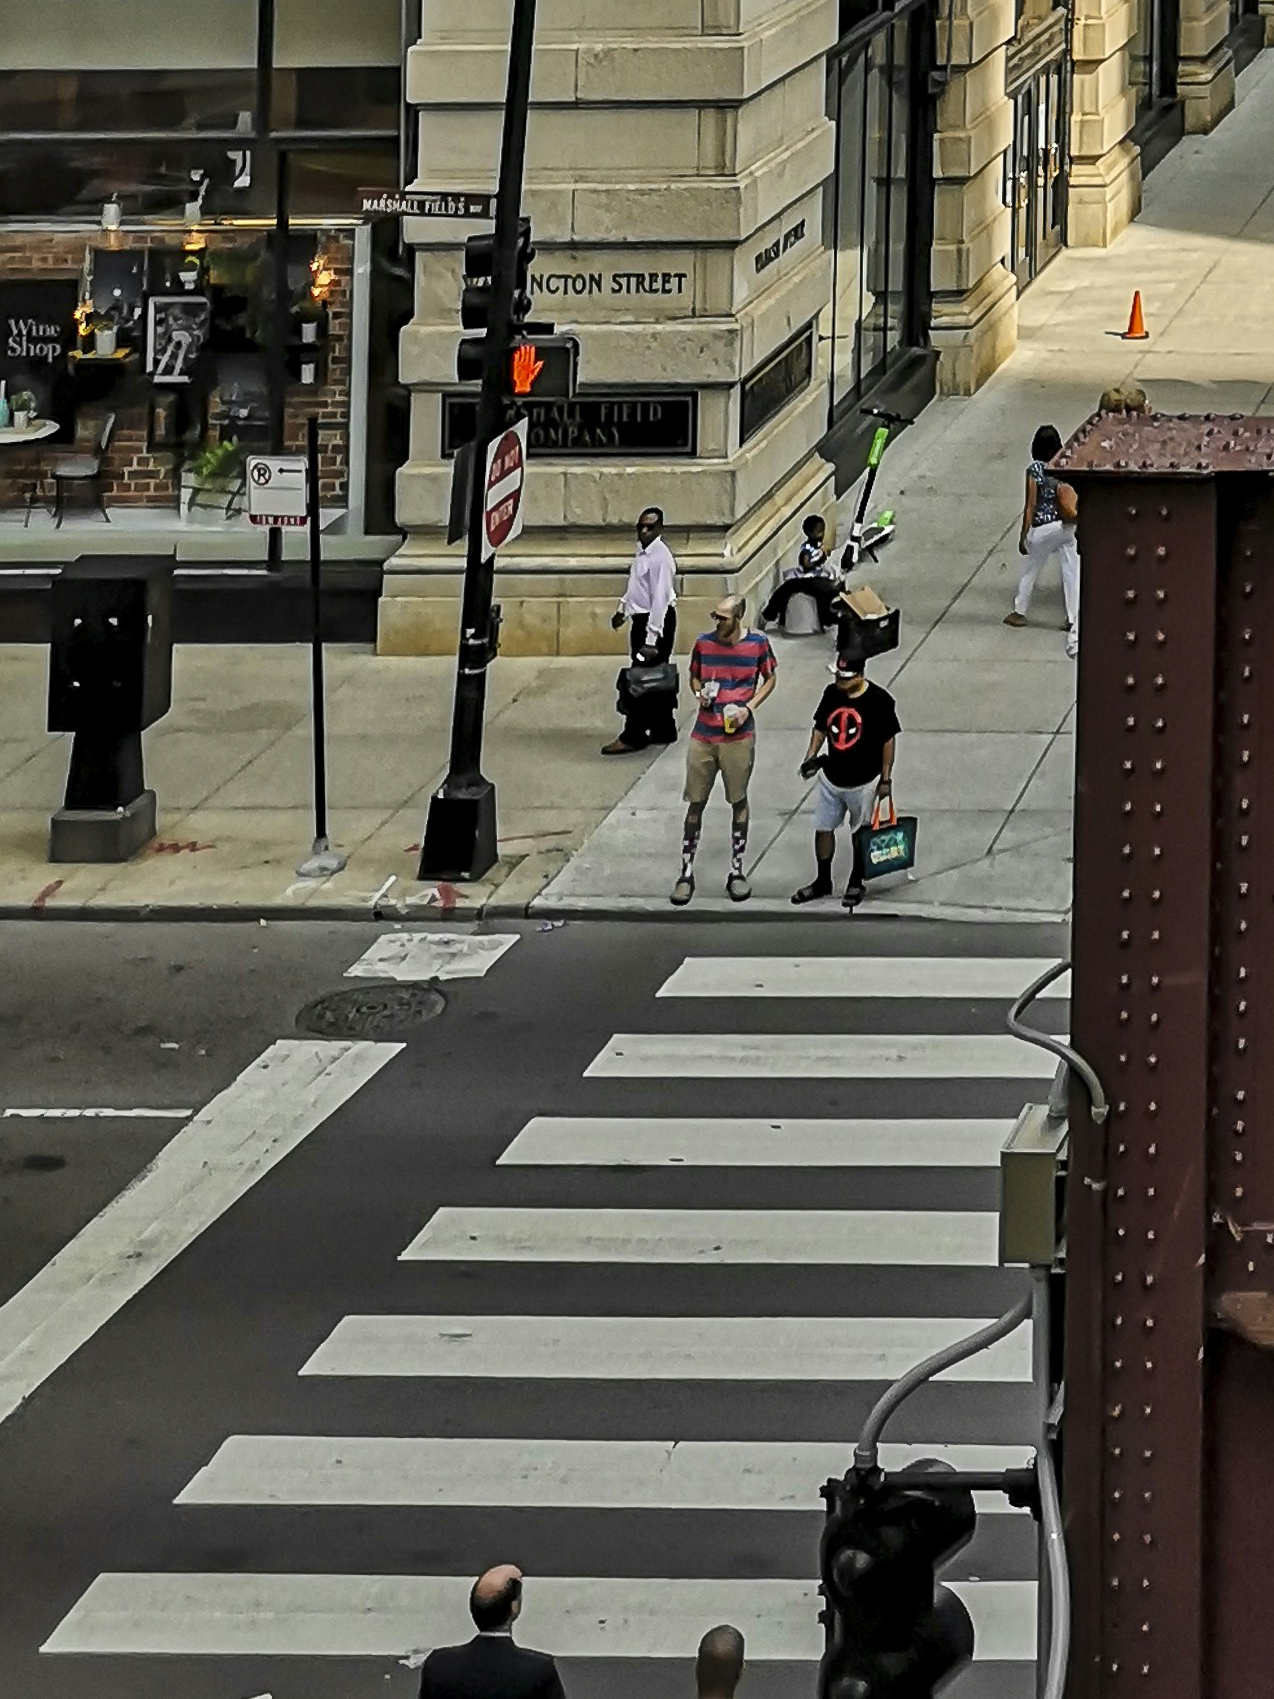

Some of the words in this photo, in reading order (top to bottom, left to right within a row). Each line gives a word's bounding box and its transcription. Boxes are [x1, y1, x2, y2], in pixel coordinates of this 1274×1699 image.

[362, 196, 420, 214] MARSHALL
[530, 272, 603, 296] NGTON
[611, 272, 688, 295] STREET
[8, 318, 61, 337] Wine
[8, 336, 62, 364] Shop
[600, 402, 663, 423] FIELD
[530, 426, 622, 447] OMPANY
